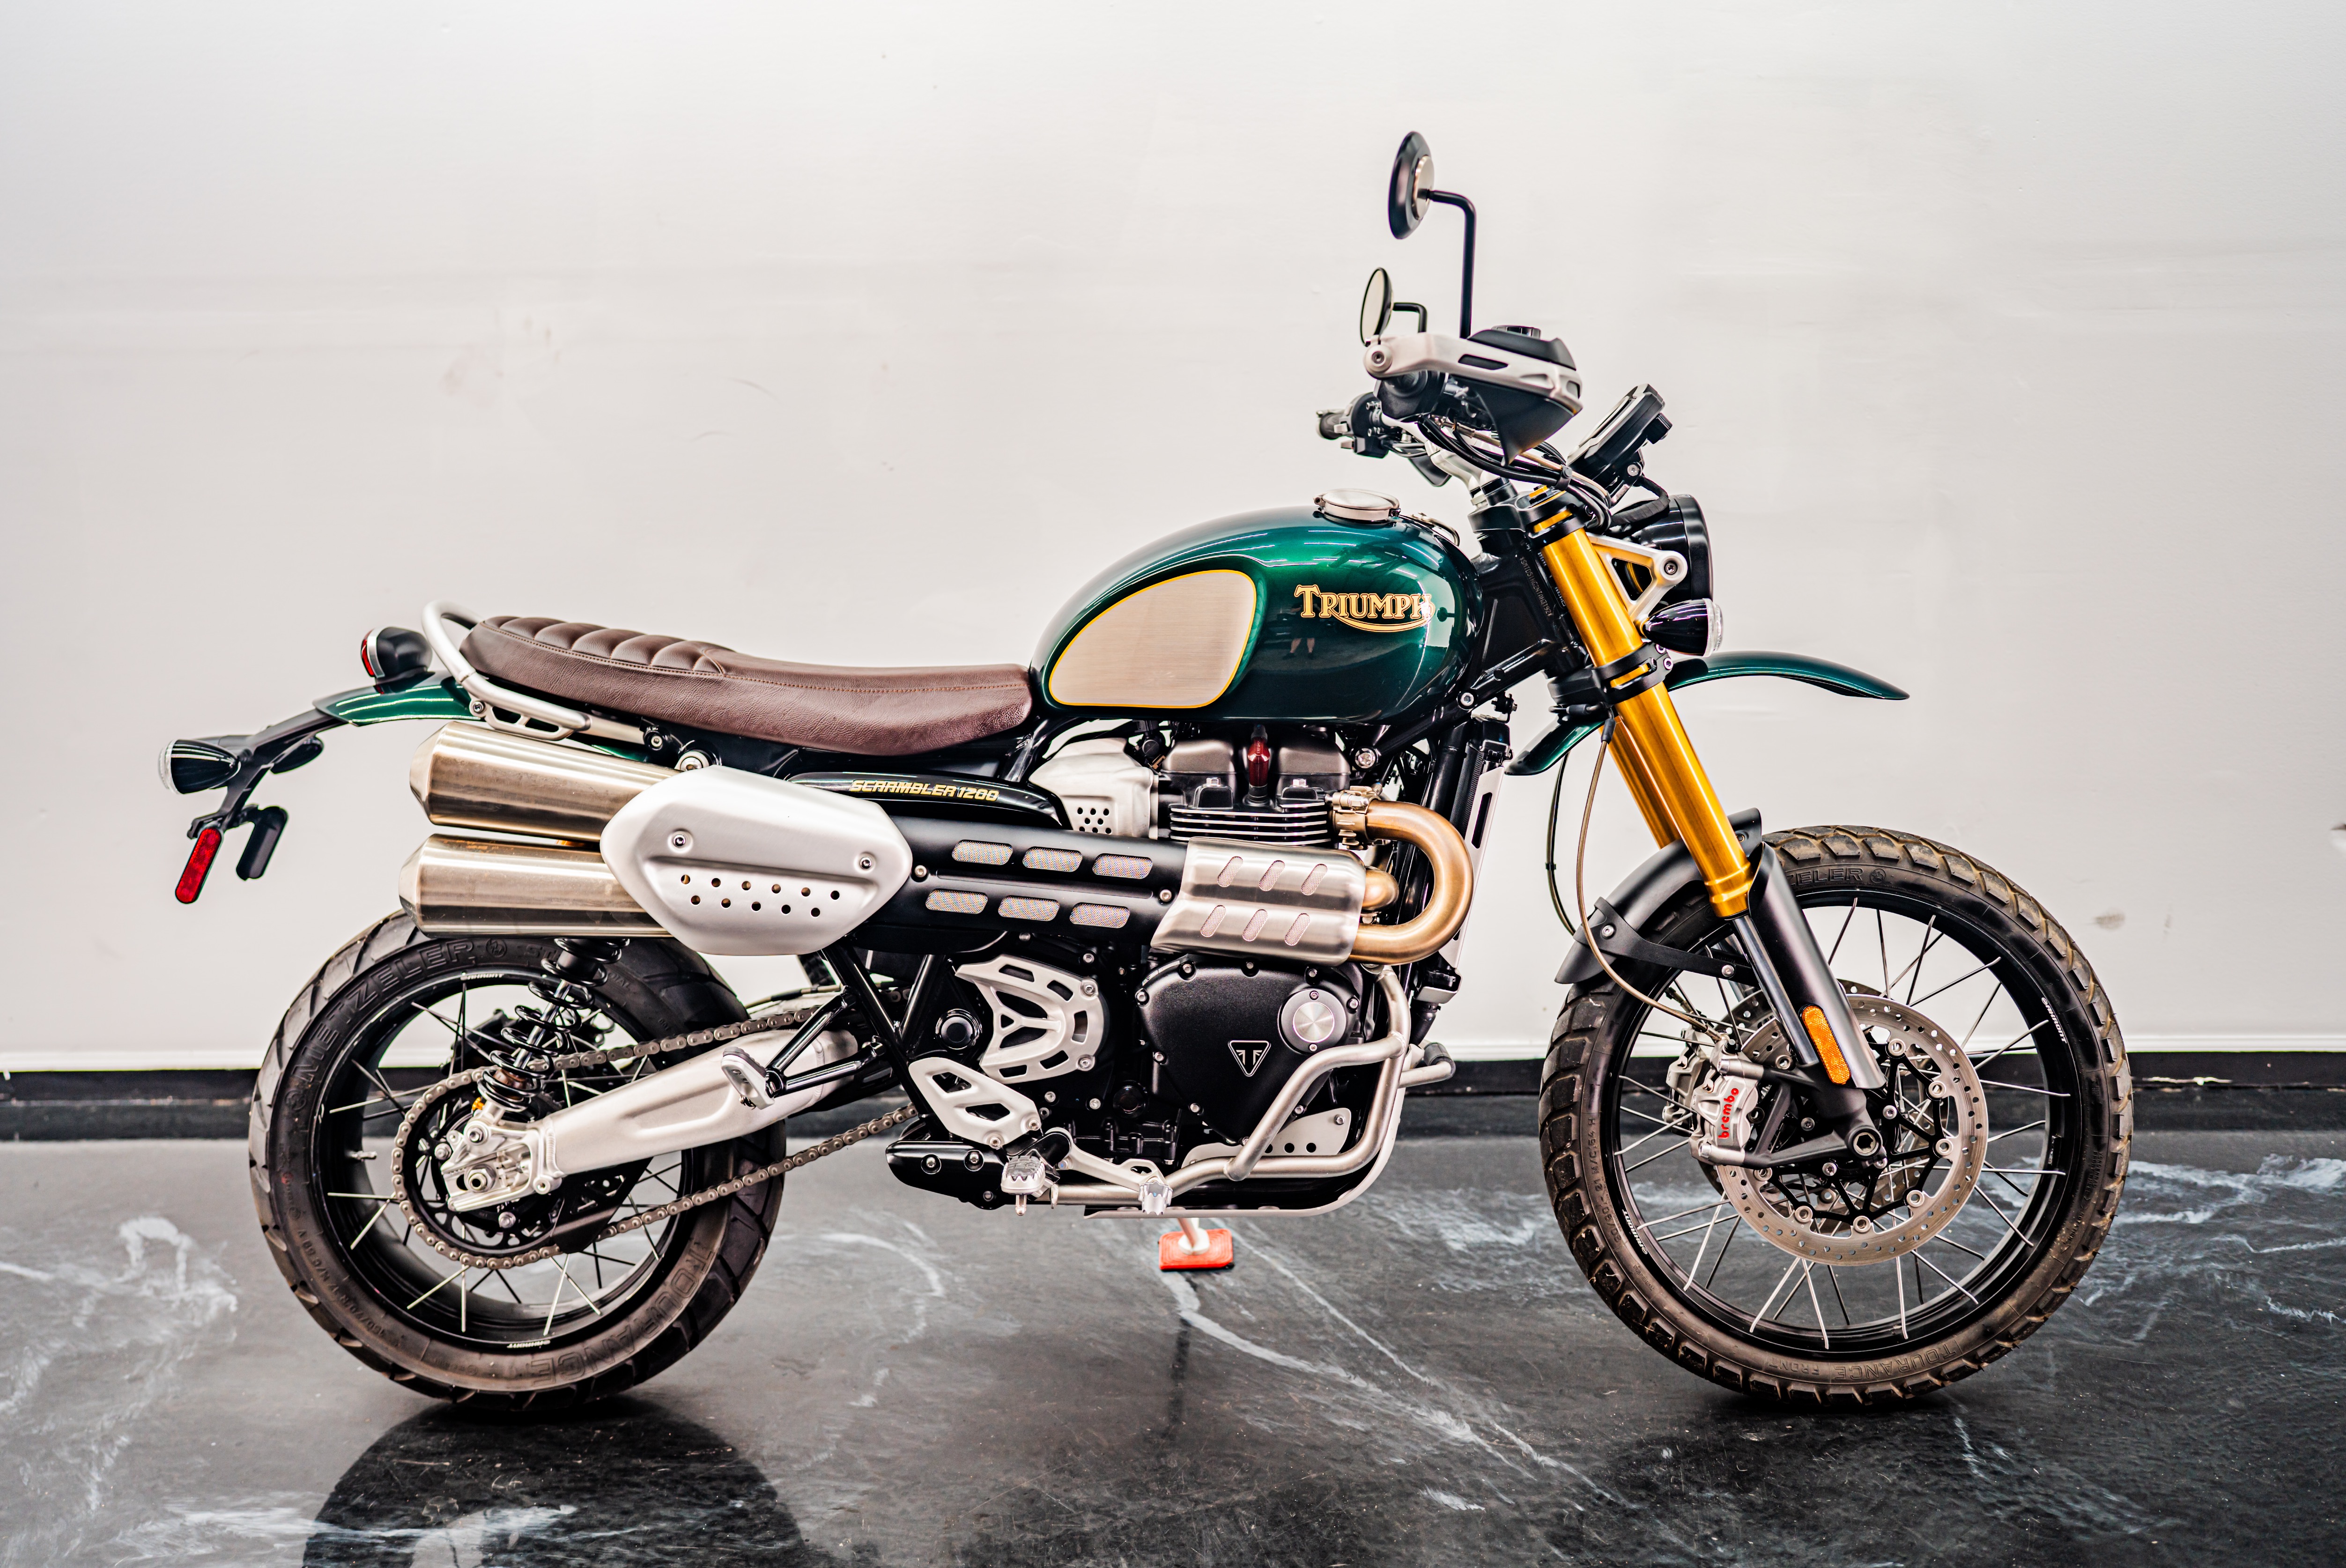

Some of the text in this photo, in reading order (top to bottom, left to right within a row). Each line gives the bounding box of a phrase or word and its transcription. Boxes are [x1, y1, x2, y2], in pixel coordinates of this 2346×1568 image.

[1294, 584, 1436, 632] TRIUMPH
[850, 780, 999, 802] SCRAMBLER 1200
[292, 939, 474, 1083] METZELER
[1588, 1117, 1596, 1126] H
[1718, 1087, 1739, 1139] brembo
[1593, 1177, 1604, 1192] 21
[530, 1240, 717, 1384] TOURANCE
[1768, 1343, 1957, 1381] TOURANCE FRONT
